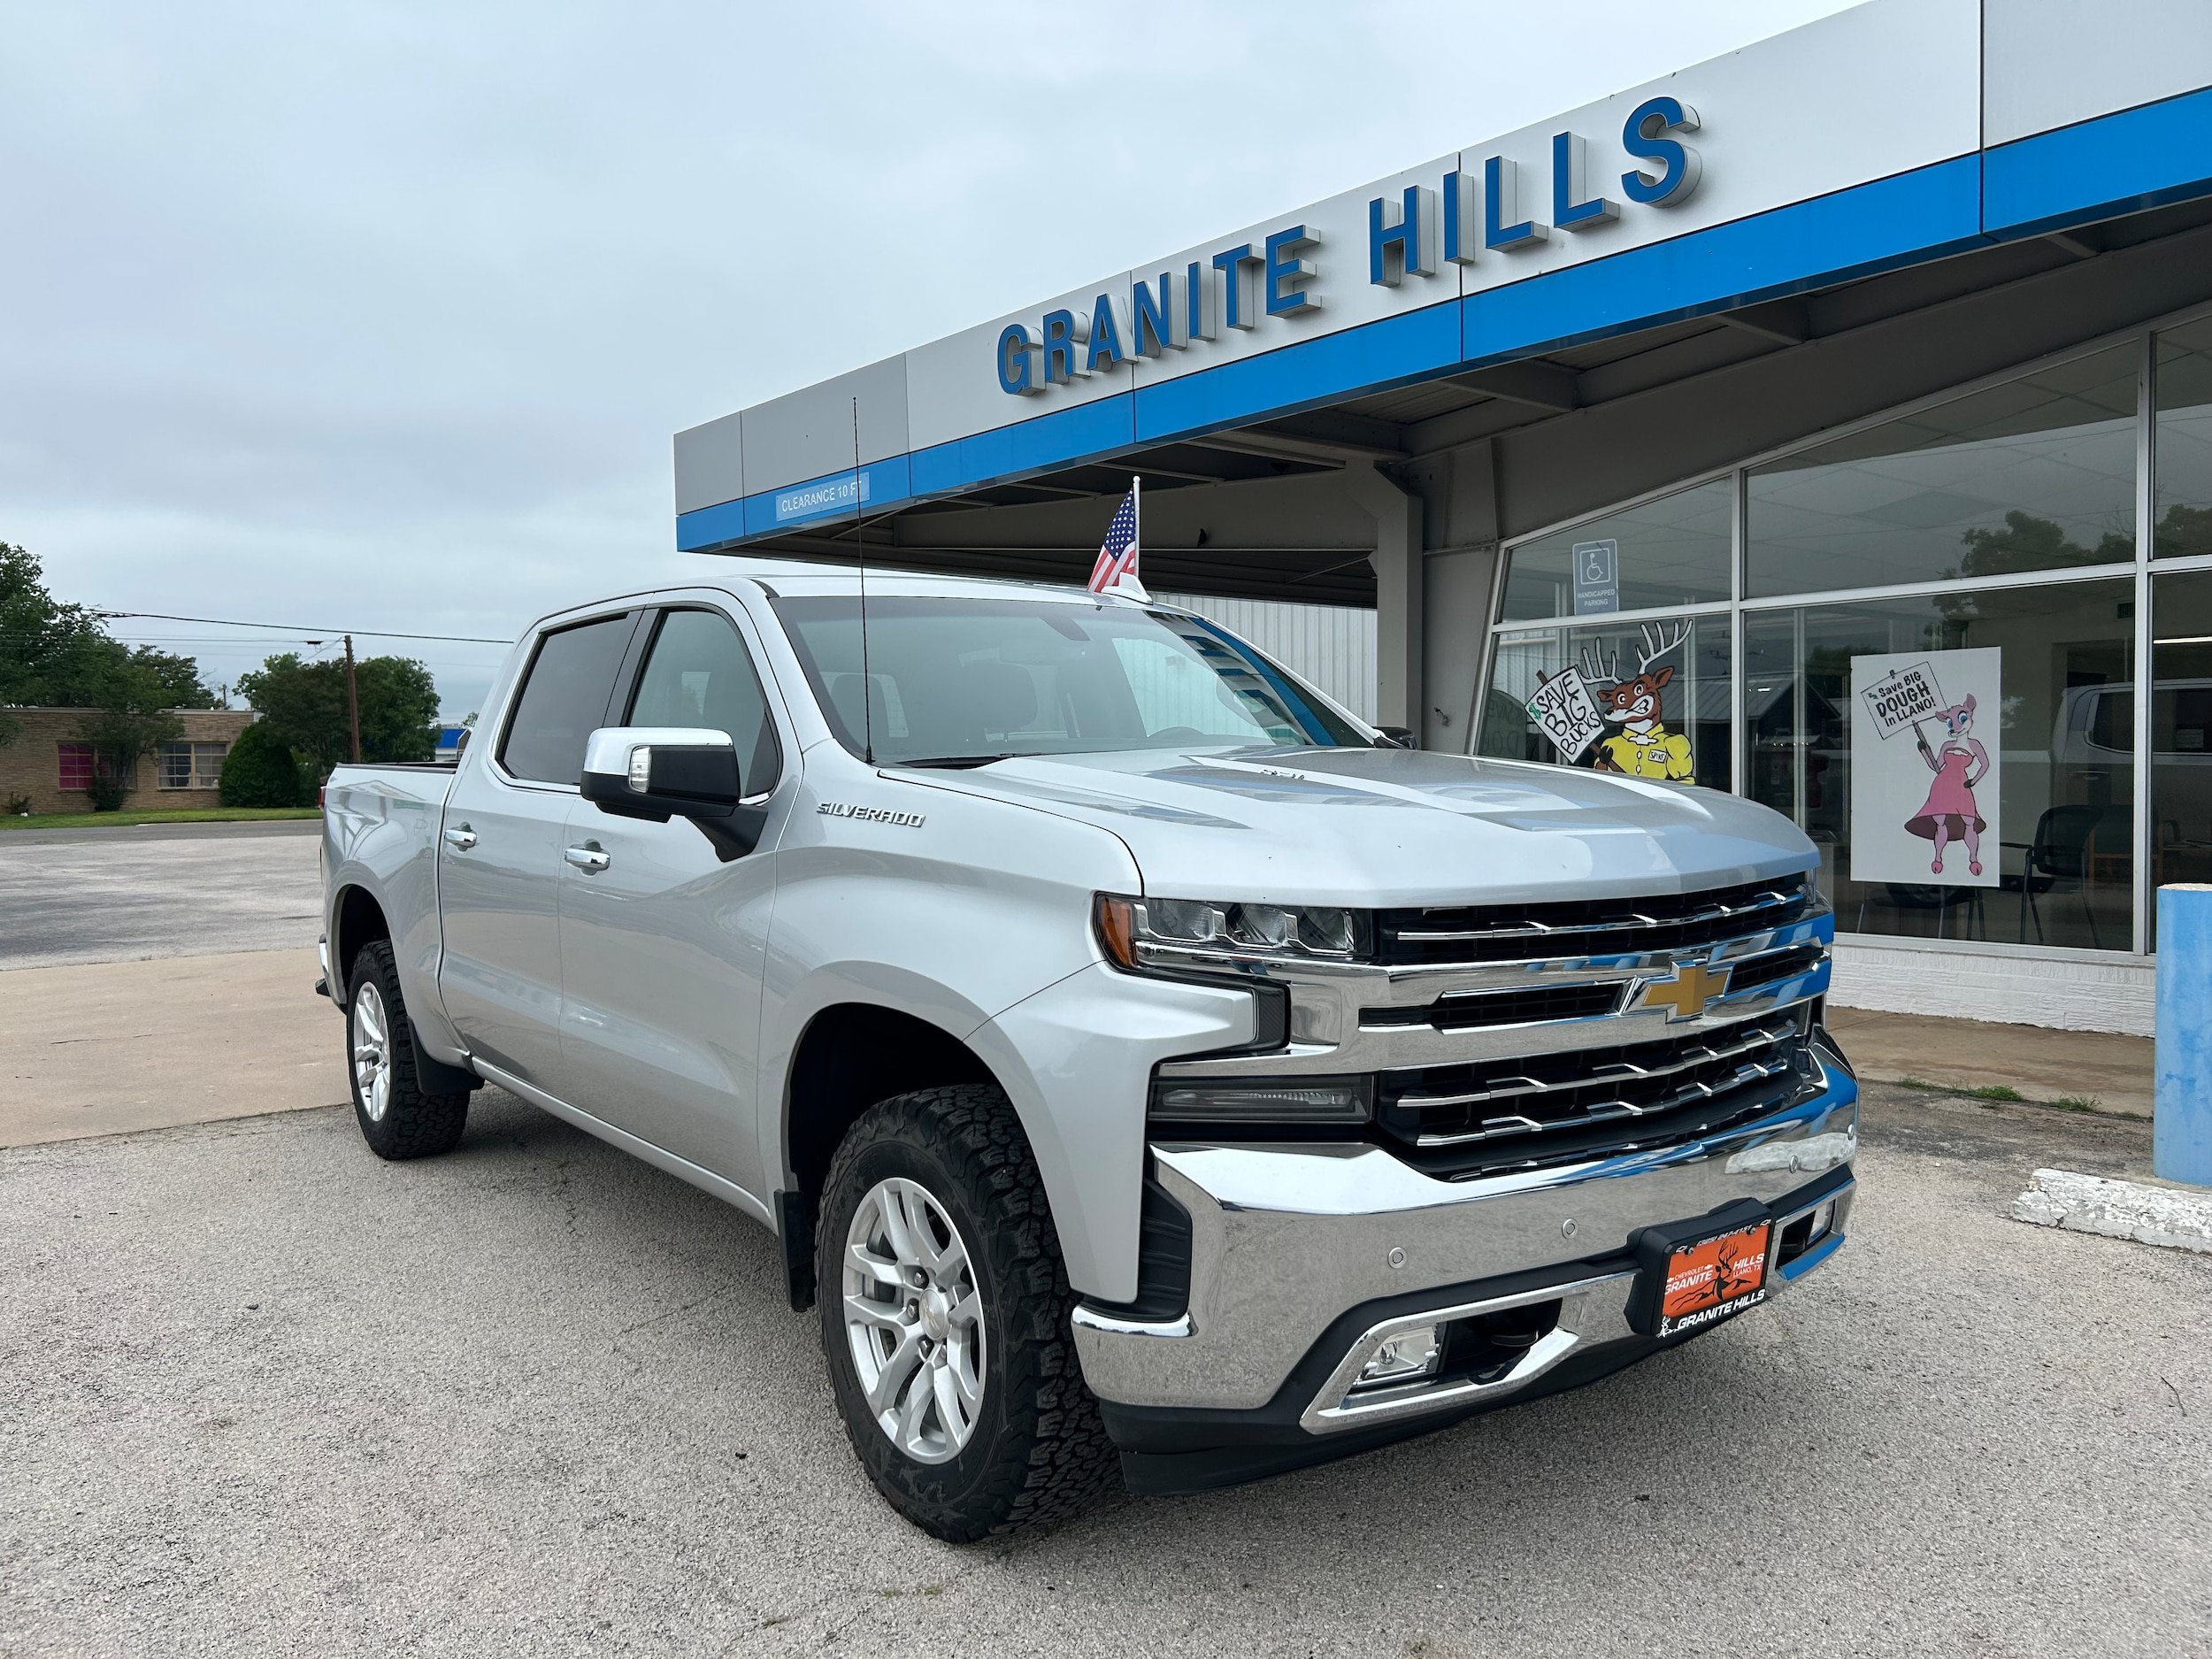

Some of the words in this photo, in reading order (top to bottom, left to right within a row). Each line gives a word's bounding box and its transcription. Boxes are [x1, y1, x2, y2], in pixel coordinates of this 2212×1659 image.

[997, 224, 1321, 396] GRANITE
[1369, 96, 1701, 288] HILLS
[781, 487, 835, 512] CLEARANCE
[837, 484, 849, 499] 10
[1577, 588, 1616, 599] HANDICAPPED
[1584, 598, 1609, 608] PARKING
[1536, 672, 1580, 714] SAVE
[1878, 681, 1903, 697] Save
[1903, 671, 1922, 687] BIG
[1876, 680, 1932, 718] DOUGH
[1895, 695, 1937, 722] LLANO!
[1544, 695, 1586, 737] BIG
[1560, 710, 1601, 756] BUCKS
[1649, 750, 1666, 761] SPIKE
[816, 801, 926, 828] SILVERADO
[1664, 1269, 1714, 1295] GRANITE
[1732, 1252, 1765, 1271] HILLS
[1674, 1265, 1705, 1281] CHEVROLET
[1677, 1302, 1734, 1330] GRANITE
[1732, 1288, 1766, 1311] HILLS
